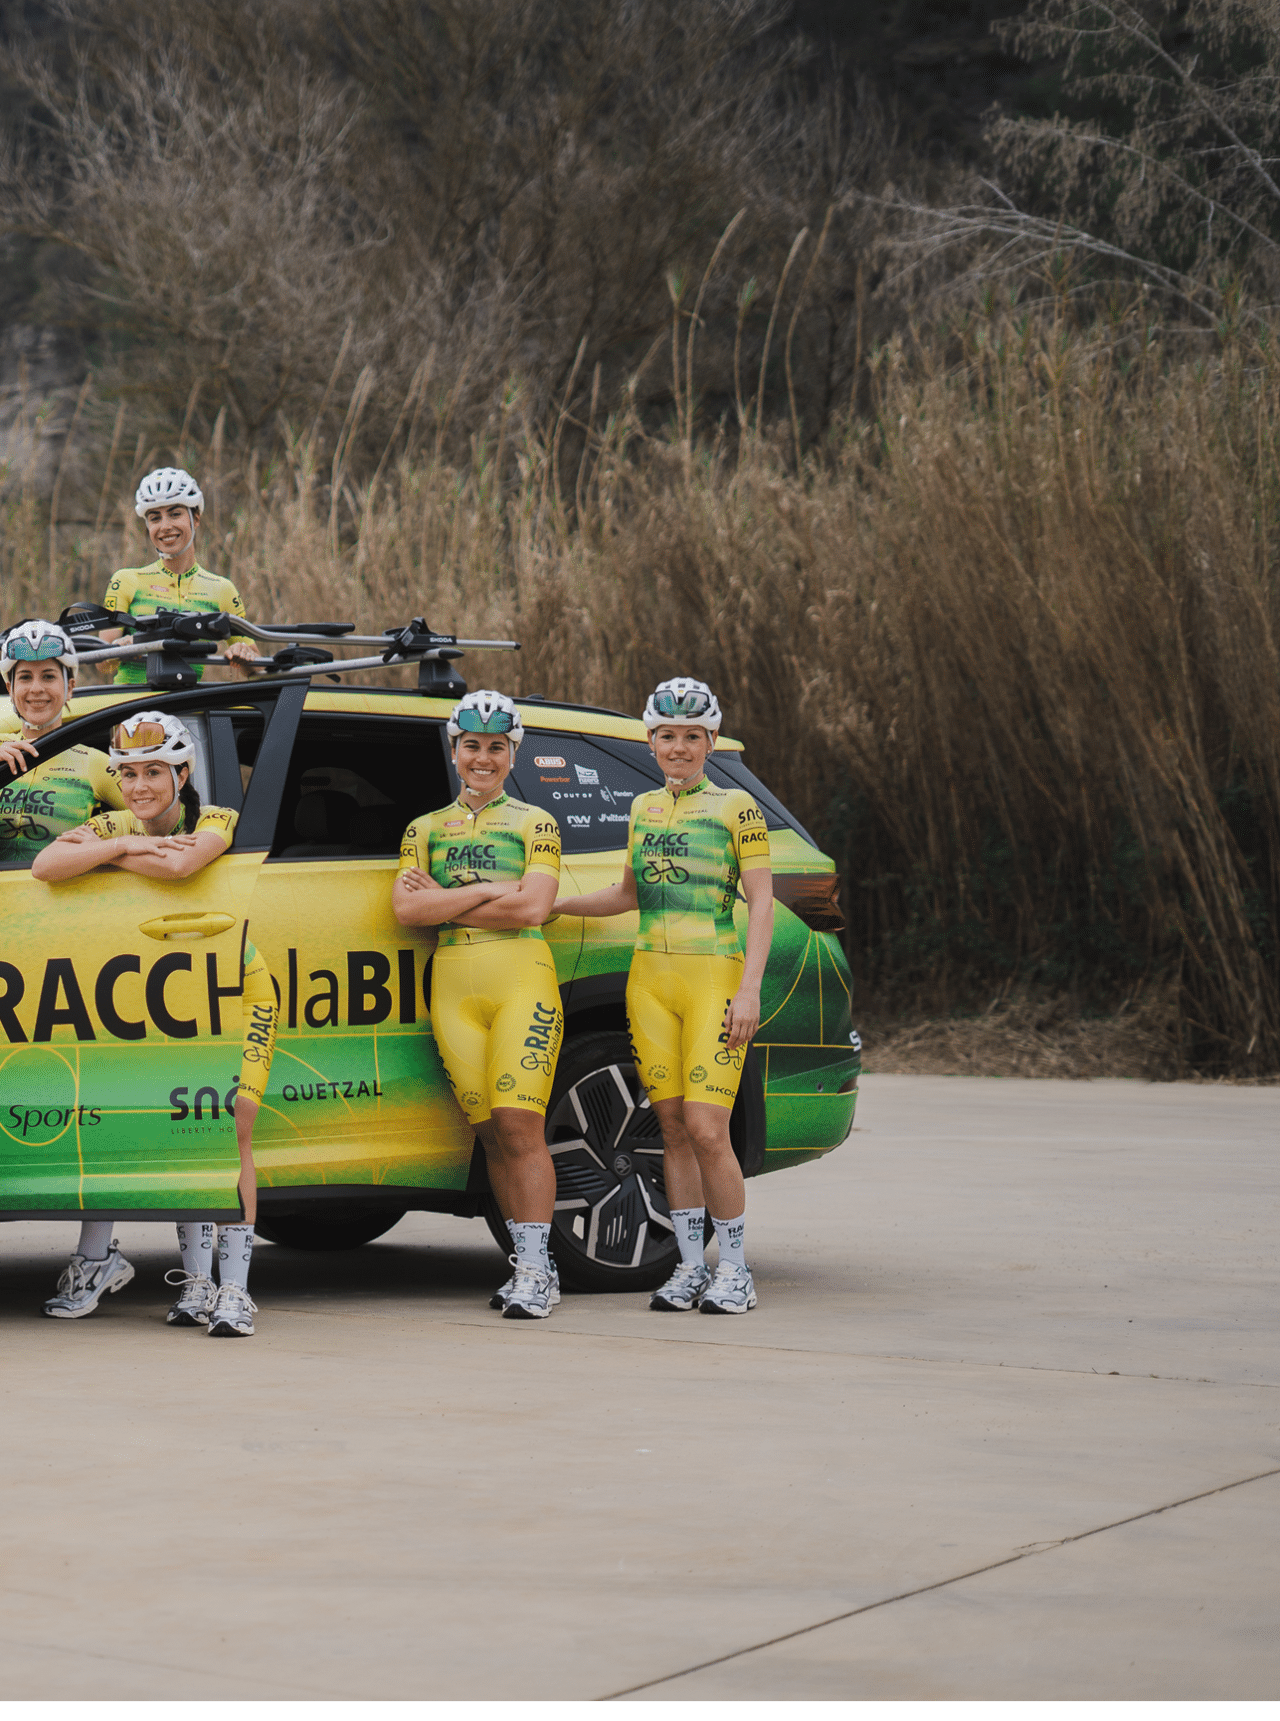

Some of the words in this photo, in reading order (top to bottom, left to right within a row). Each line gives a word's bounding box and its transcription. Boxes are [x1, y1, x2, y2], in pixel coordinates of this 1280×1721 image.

[642, 832, 689, 847] RACC
[741, 832, 767, 844] RACC
[446, 844, 496, 861] RACC
[247, 1005, 273, 1047] RACC
[524, 1001, 557, 1051] RACC
[282, 1080, 383, 1102] QUETZAL
[6, 1102, 102, 1136] Sports
